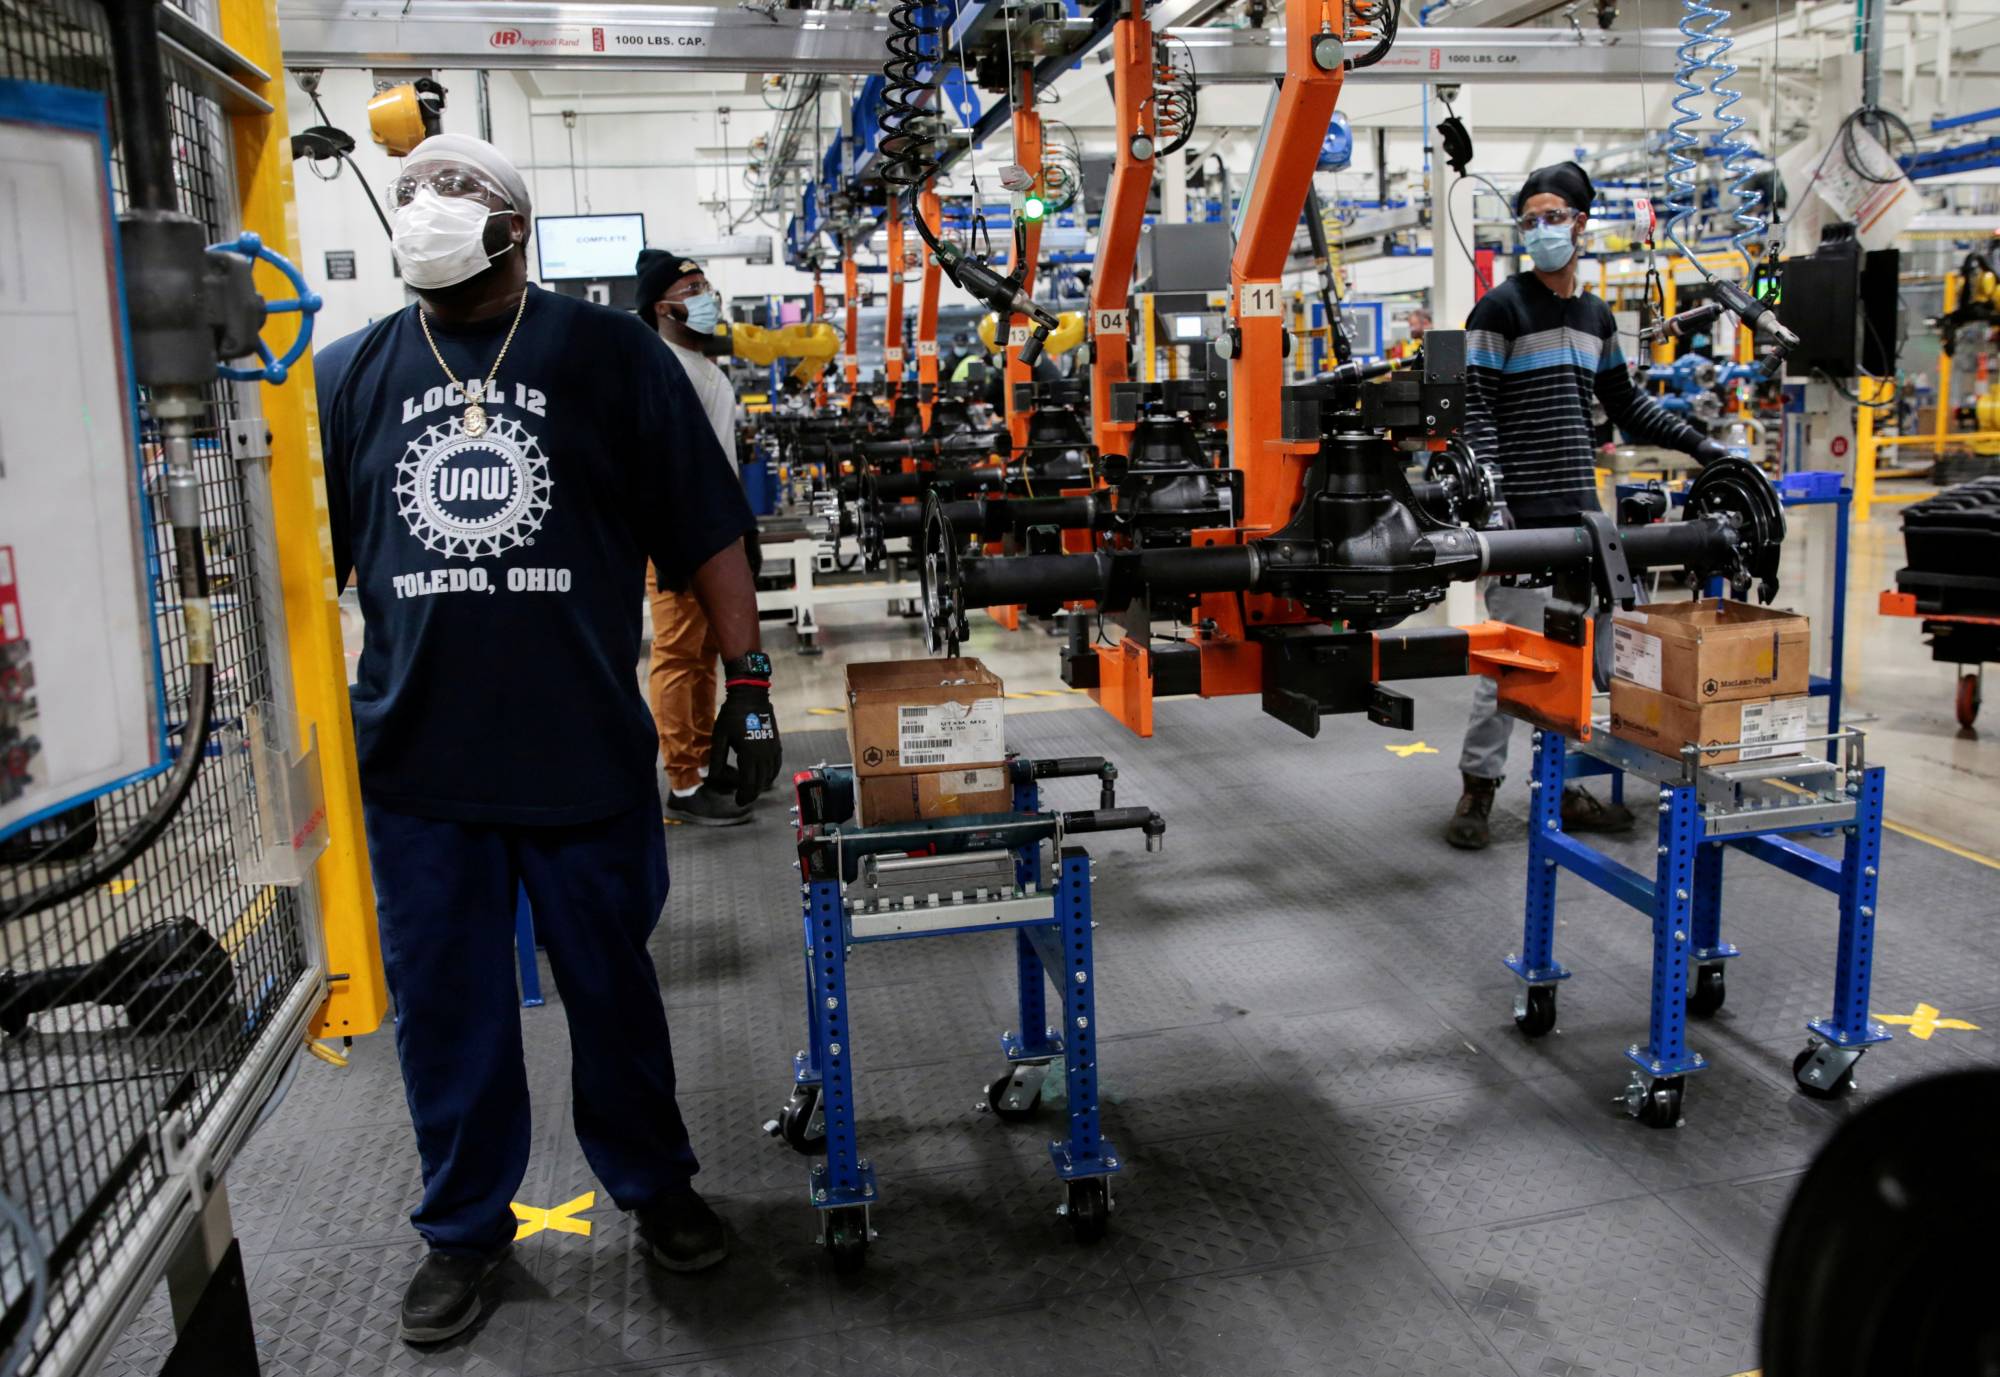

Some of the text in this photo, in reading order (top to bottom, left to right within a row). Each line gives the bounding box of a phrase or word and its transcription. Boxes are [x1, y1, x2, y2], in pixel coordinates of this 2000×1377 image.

[493, 30, 579, 47] IR Ingersoll Rand
[615, 35, 706, 47] 1000 LBS. CAP.
[1448, 55, 1520, 64] 1000 LBS. CAP.
[576, 235, 627, 244] COMPLETE
[1251, 288, 1274, 310] 11
[1101, 313, 1122, 329] 04
[1010, 329, 1027, 342] 13
[402, 378, 547, 425] LOCAL 12
[439, 466, 511, 501] UAW
[392, 567, 572, 600] TOLEDO, OHIO
